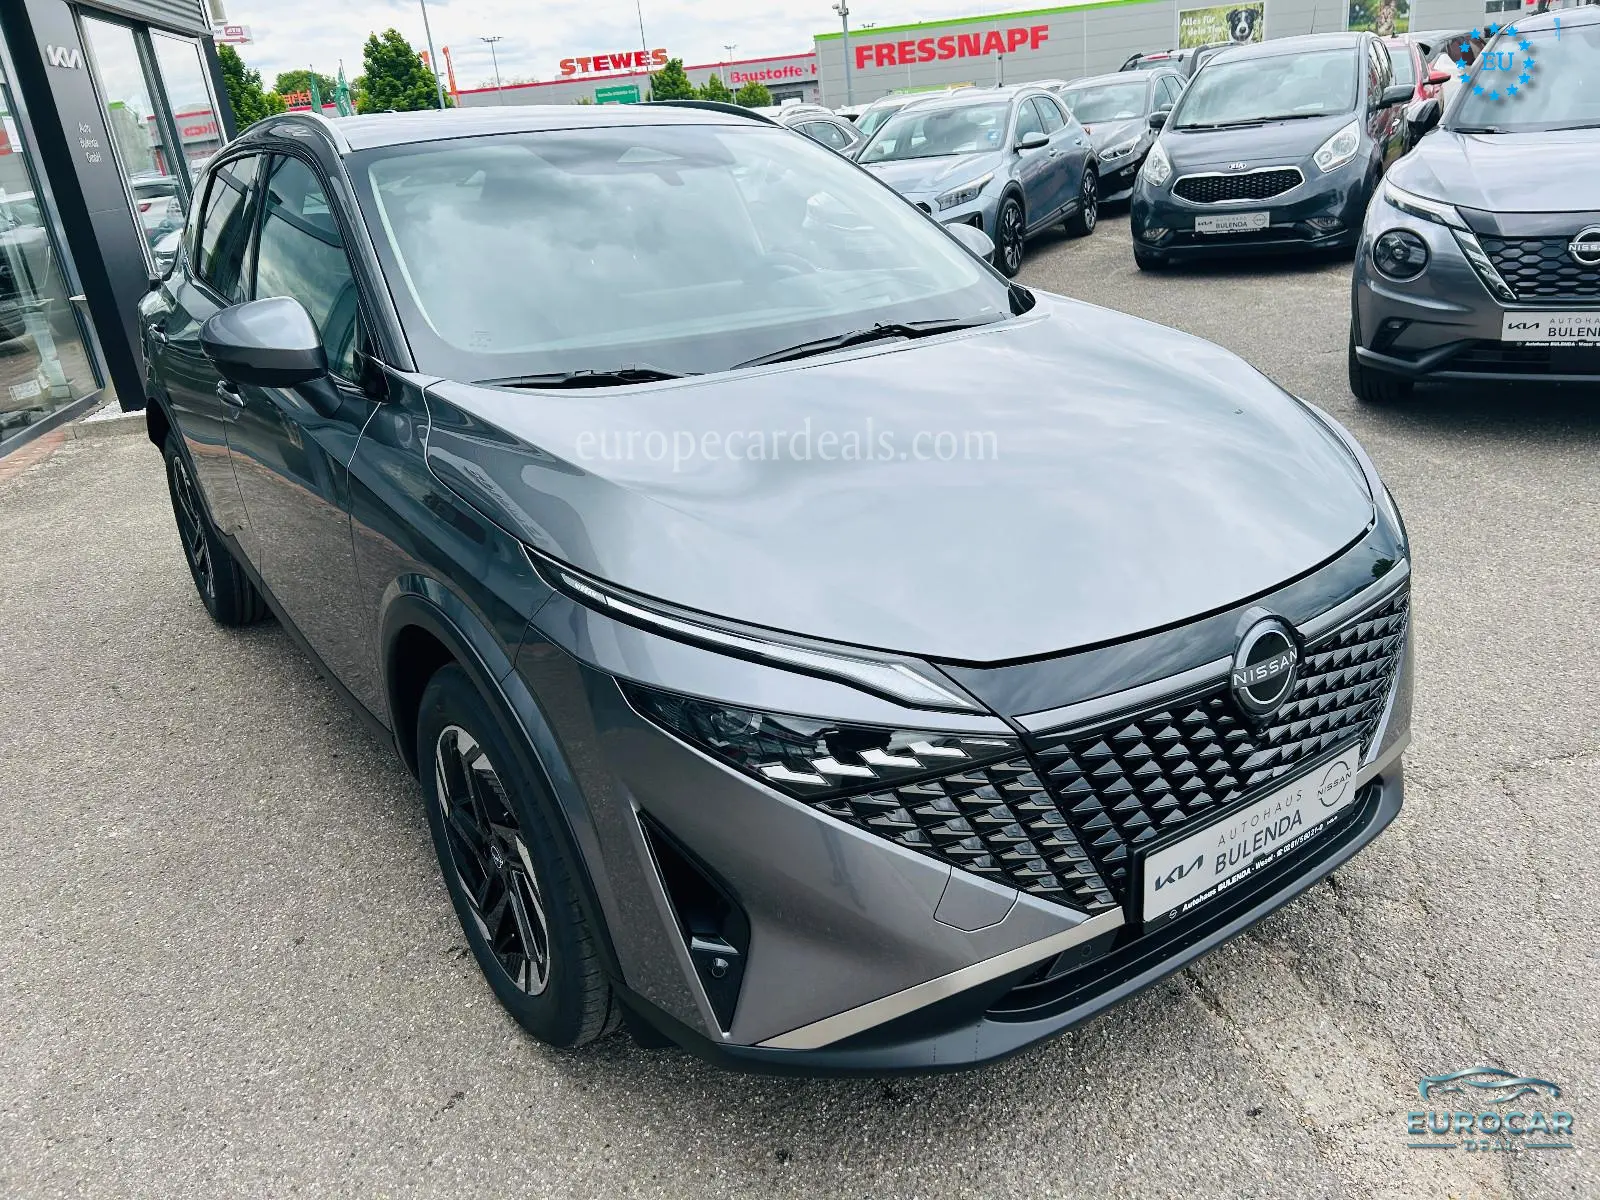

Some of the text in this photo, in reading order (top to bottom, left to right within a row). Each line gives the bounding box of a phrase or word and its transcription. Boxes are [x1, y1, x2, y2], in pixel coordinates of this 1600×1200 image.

[1181, 15, 1215, 26] Alles für
[560, 48, 669, 76] STEWES
[855, 25, 1049, 69] FRESSNAPF
[730, 65, 803, 83] Baustoffe
[1233, 647, 1298, 686] NISSAN
[1317, 771, 1352, 798] NISSAN
[1217, 789, 1303, 848] AUTOHAUS
[1215, 809, 1302, 876] BULENDA
[1154, 854, 1204, 892] KIA
[1182, 888, 1217, 912] Autohaus
[1217, 867, 1252, 892] BULENDA
